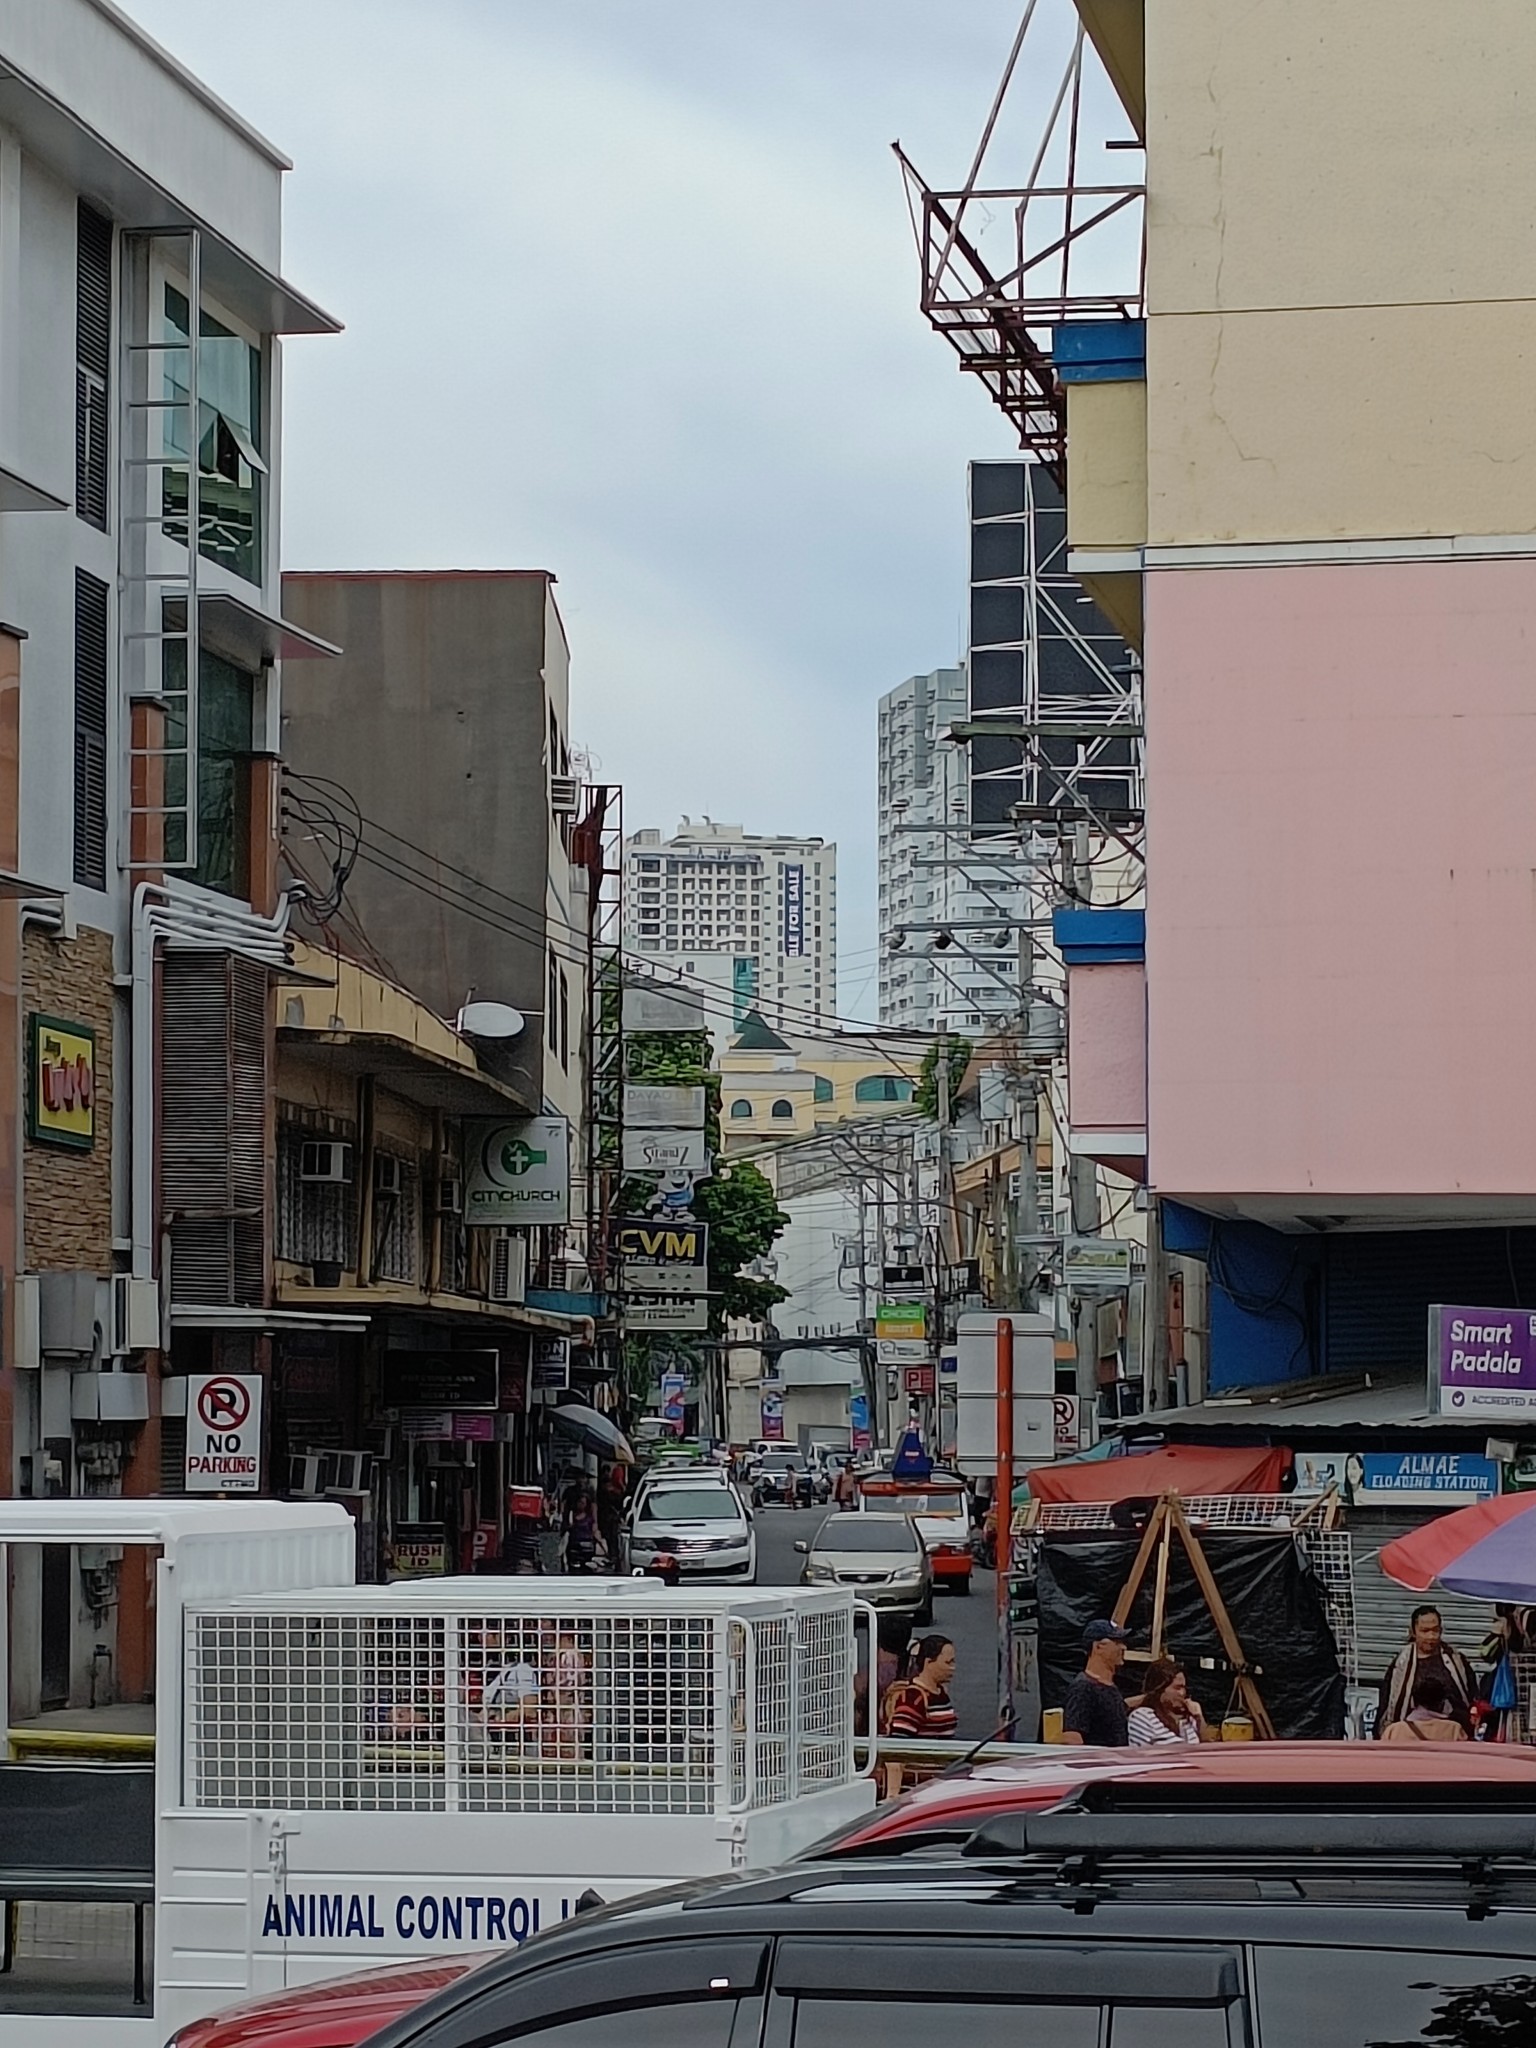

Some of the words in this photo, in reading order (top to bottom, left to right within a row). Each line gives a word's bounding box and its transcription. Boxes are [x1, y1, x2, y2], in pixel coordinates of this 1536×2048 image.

[788, 871, 800, 901] SALE
[788, 905, 800, 931] FOR
[620, 1229, 696, 1257] CVM
[1450, 1320, 1513, 1344] Smart
[1450, 1349, 1522, 1374] Padala
[1472, 1395, 1526, 1407] ACCREDITED
[206, 1434, 242, 1454] NO
[188, 1456, 257, 1474] PARKING
[1399, 1456, 1460, 1475] ALMAE
[1434, 1475, 1488, 1490] STATION
[398, 1545, 442, 1557] RUSH
[410, 1557, 430, 1567] ID
[262, 1894, 385, 1938] ANIMAL
